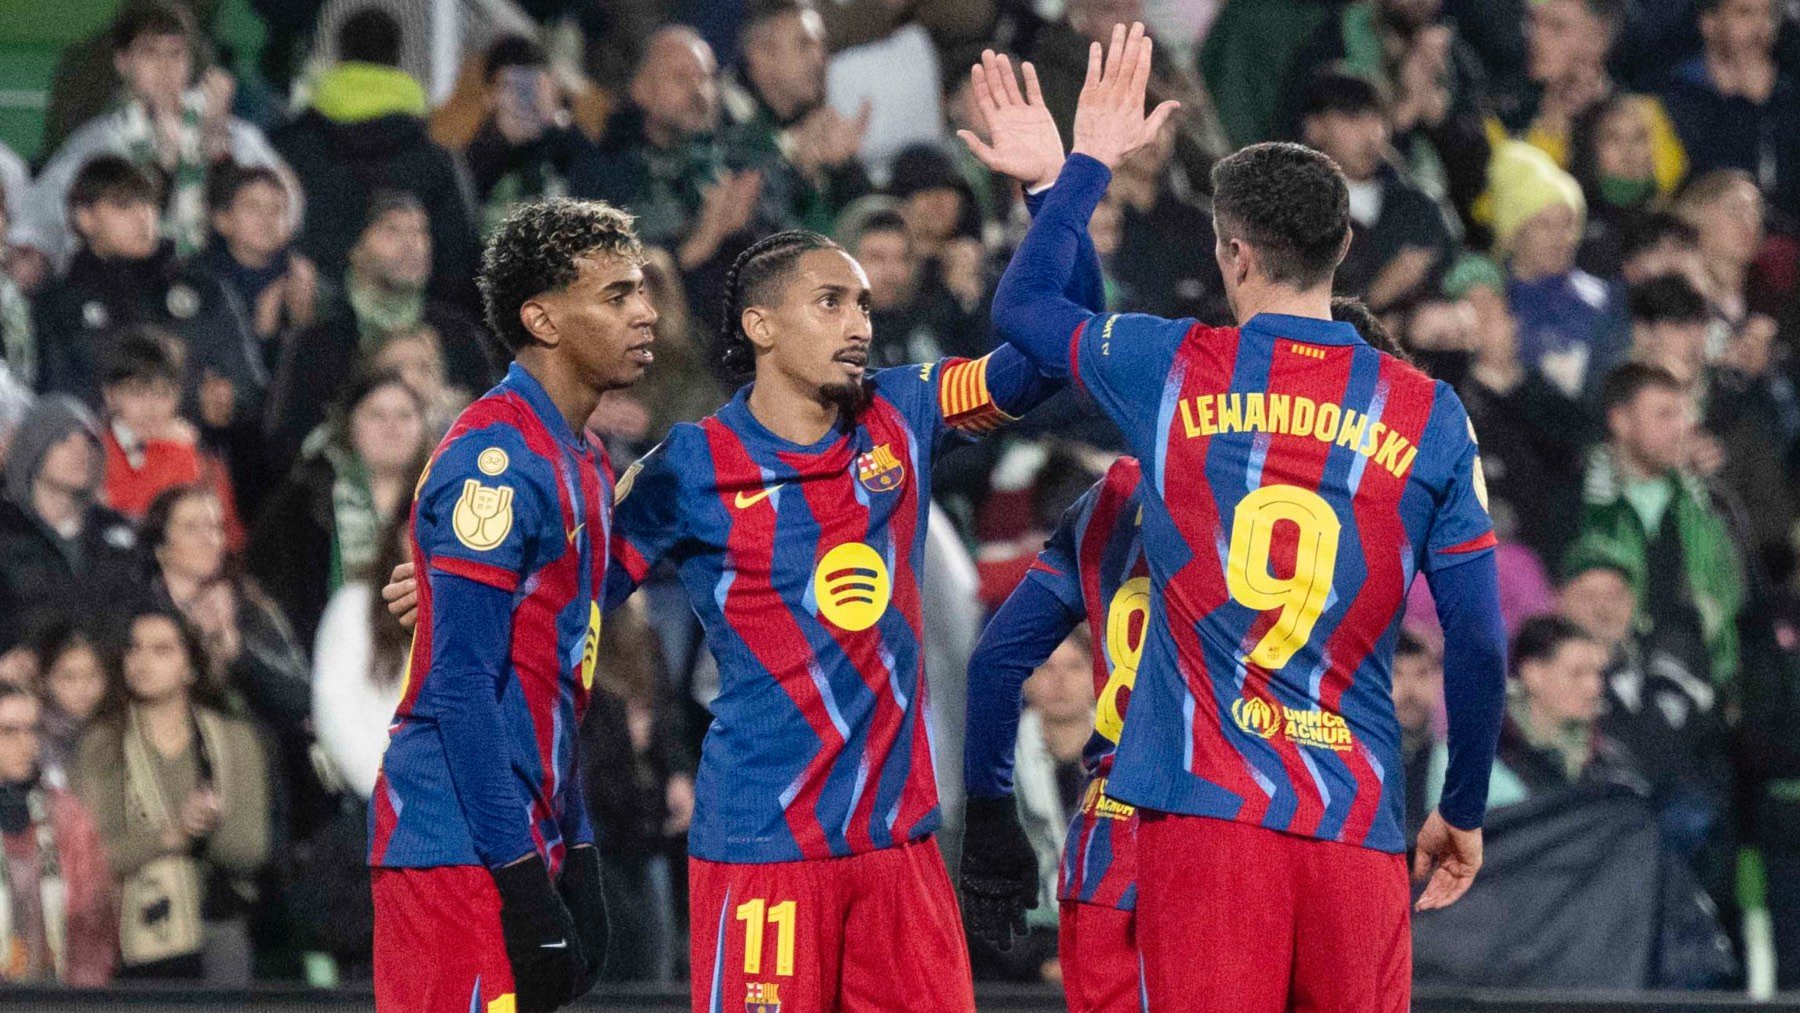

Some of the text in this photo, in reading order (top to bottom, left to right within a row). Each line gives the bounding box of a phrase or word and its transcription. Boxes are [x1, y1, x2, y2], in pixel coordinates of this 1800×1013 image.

[1179, 393, 1418, 478] LEWANDOWSKI
[1227, 484, 1341, 669] 9
[1094, 577, 1150, 746] 8
[1282, 706, 1348, 729] UNHCR
[1284, 721, 1353, 744] ACNUR
[736, 898, 797, 976] 11
